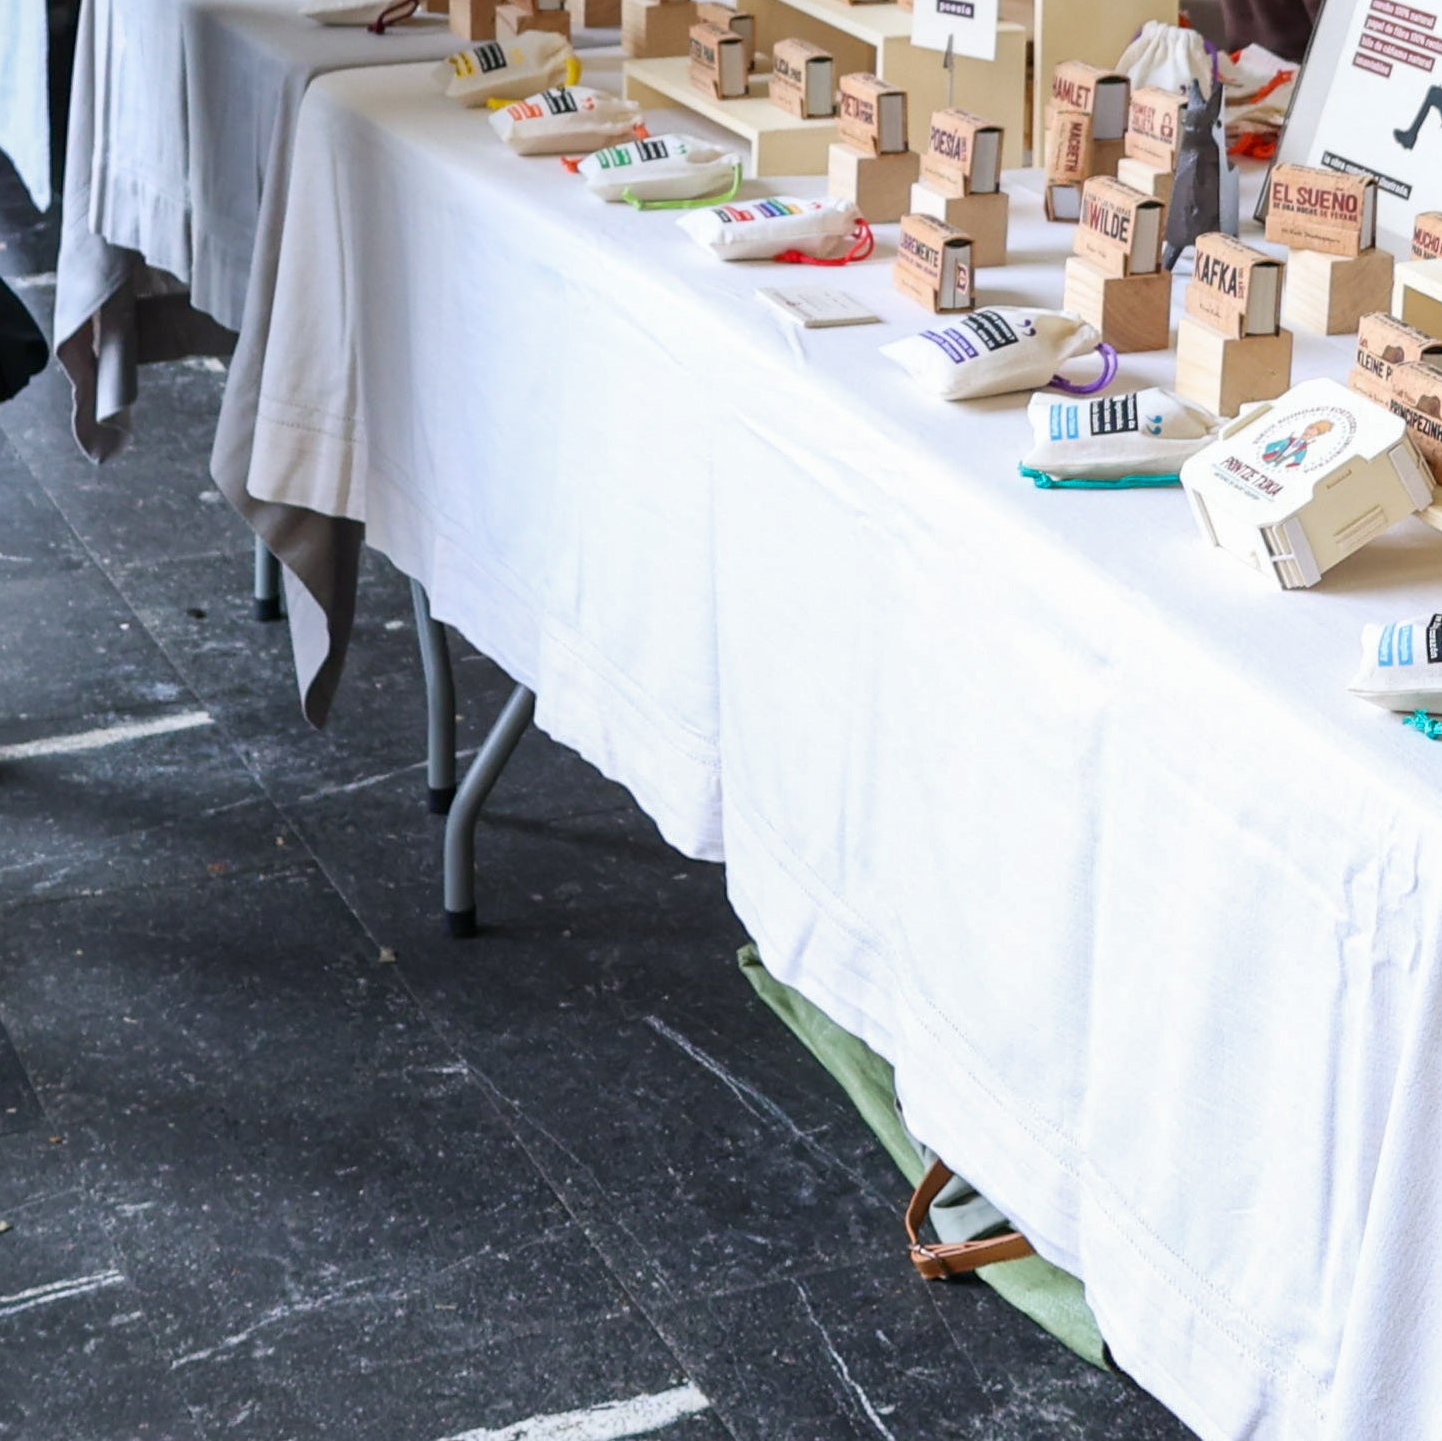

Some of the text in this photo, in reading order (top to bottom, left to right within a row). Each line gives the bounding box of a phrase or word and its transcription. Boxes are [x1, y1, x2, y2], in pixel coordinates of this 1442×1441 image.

[930, 125, 961, 162] POESÍA
[1064, 120, 1084, 173] MACBETH
[1272, 182, 1359, 214] EL SUEÑO
[1089, 202, 1131, 245] WILDE
[1413, 228, 1439, 253] MUCHO
[1194, 249, 1237, 299] KAFKA
